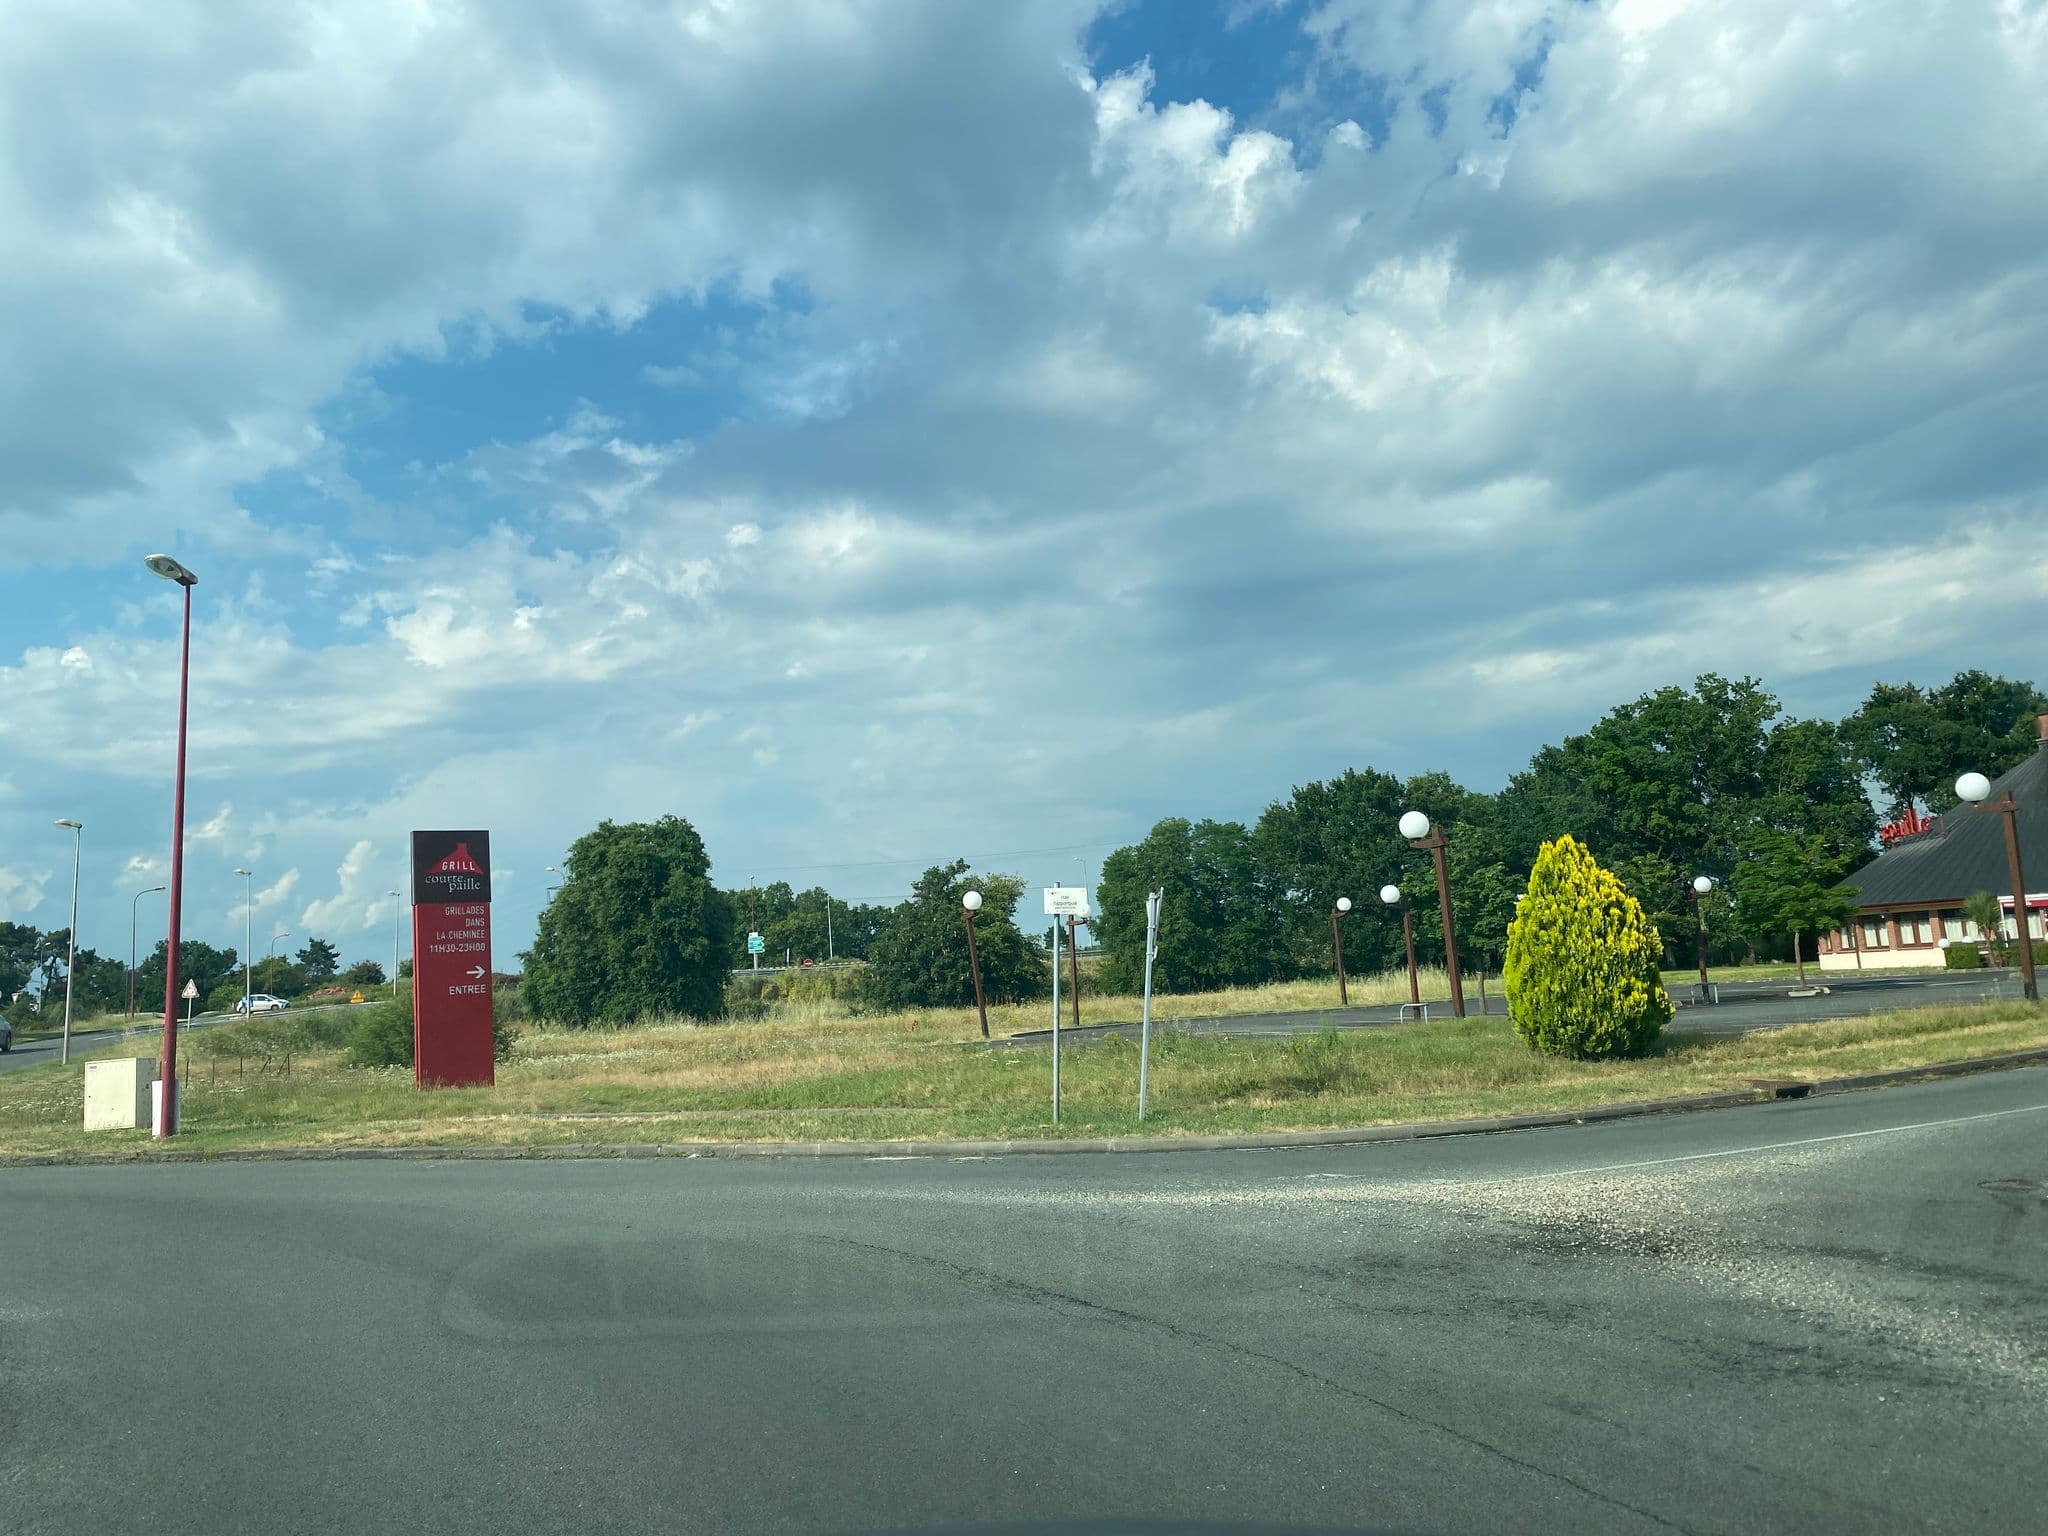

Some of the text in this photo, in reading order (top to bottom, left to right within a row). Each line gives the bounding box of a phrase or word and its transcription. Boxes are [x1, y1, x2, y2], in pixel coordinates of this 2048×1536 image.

[441, 861, 476, 871] GRILL
[448, 878, 481, 893] paille
[444, 905, 485, 916] GRILLADES
[465, 918, 485, 928] DANS
[436, 931, 446, 941] LA
[430, 942, 486, 953] 11H30-23H00
